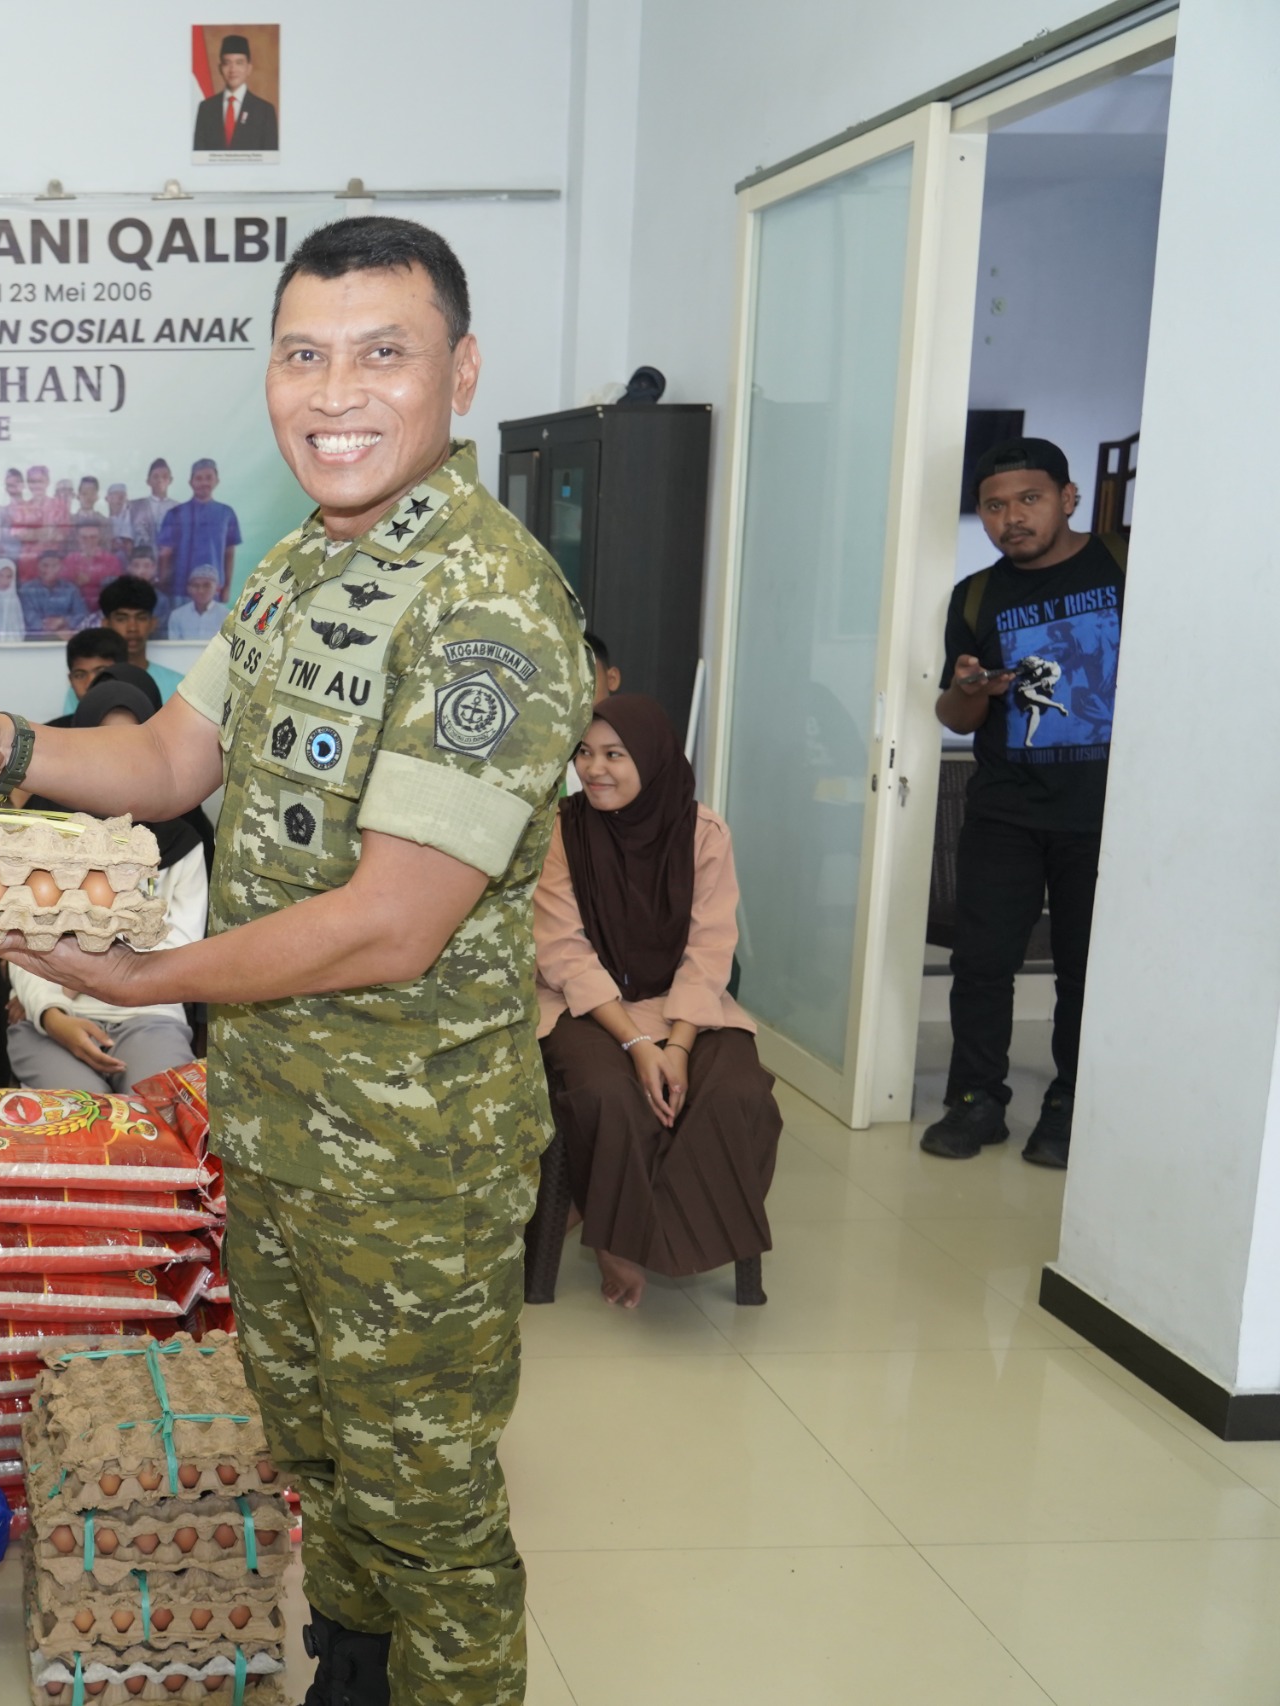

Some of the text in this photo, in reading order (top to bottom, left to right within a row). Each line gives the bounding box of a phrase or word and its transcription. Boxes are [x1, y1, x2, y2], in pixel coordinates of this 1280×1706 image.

[107, 216, 288, 271] QALBI
[9, 283, 37, 303] 23
[45, 282, 86, 302] Mei
[93, 281, 153, 302] 2006
[29, 318, 145, 345] SOSIAL
[154, 317, 253, 343] ANAK
[996, 604, 1040, 632] GUNS
[1064, 585, 1117, 616] ROSES
[244, 647, 262, 674] SS
[449, 643, 520, 669] KOGABWILHAN
[288, 657, 371, 706] TNI AU
